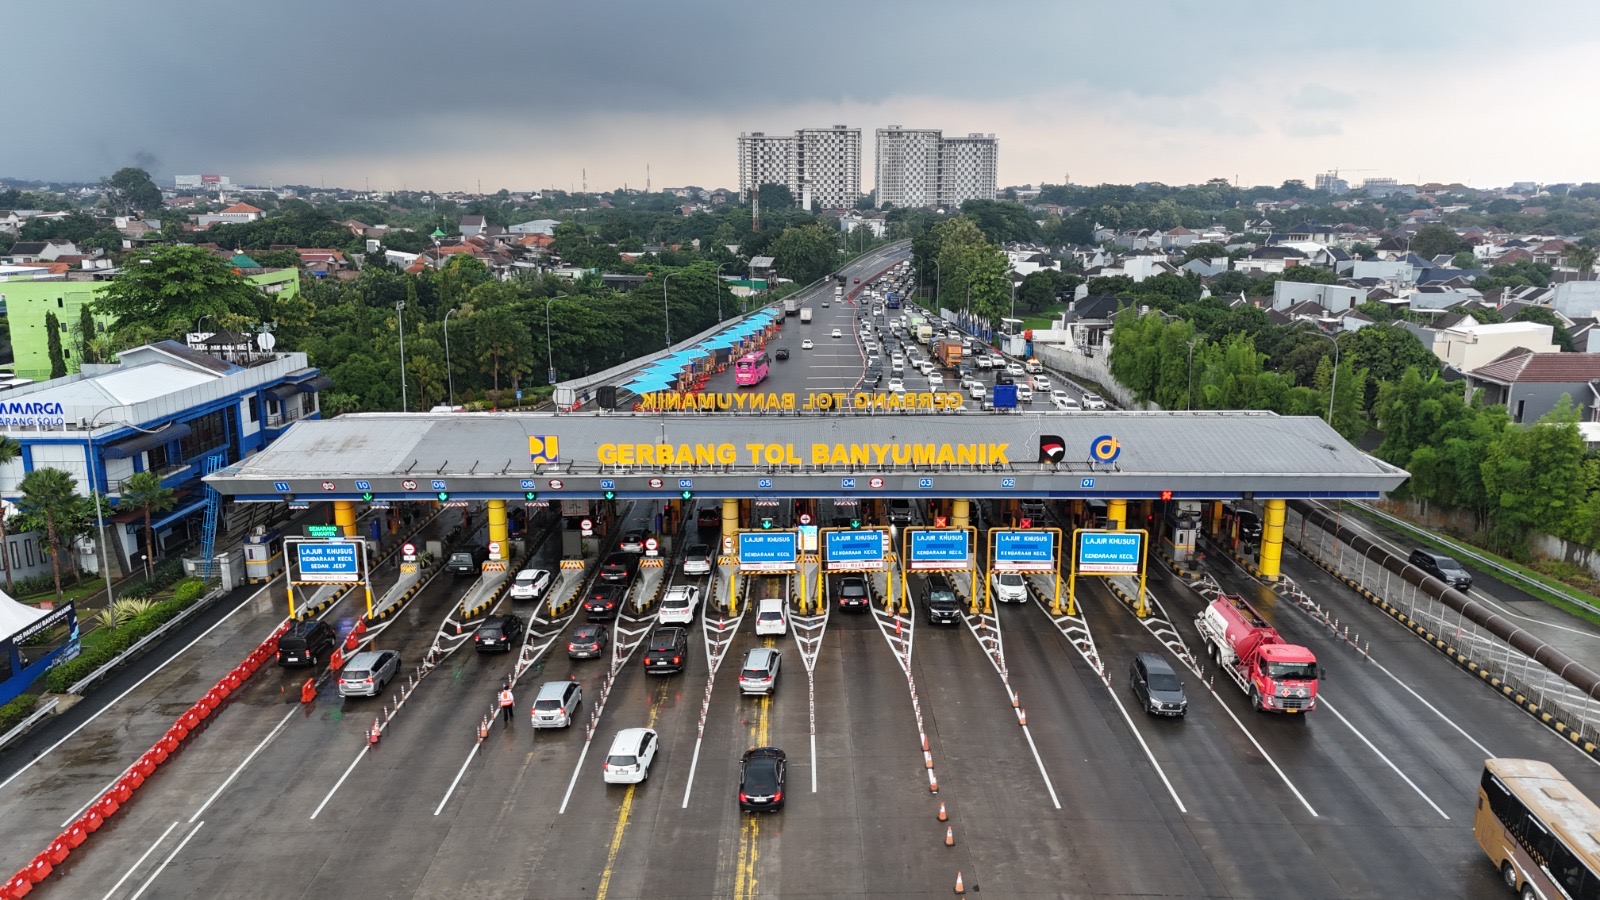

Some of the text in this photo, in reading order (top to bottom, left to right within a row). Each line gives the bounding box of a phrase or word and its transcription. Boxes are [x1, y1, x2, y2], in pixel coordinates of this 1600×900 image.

[37, 417, 64, 426] SOLO
[597, 443, 1009, 465] GERBANG TOL BANYUMANIK
[357, 481, 368, 489] 10
[760, 479, 771, 487] 05
[843, 479, 855, 487] 04
[920, 479, 932, 487] 03
[1002, 479, 1014, 487] 02
[1082, 479, 1093, 487] 01
[12, 634, 23, 645] POS
